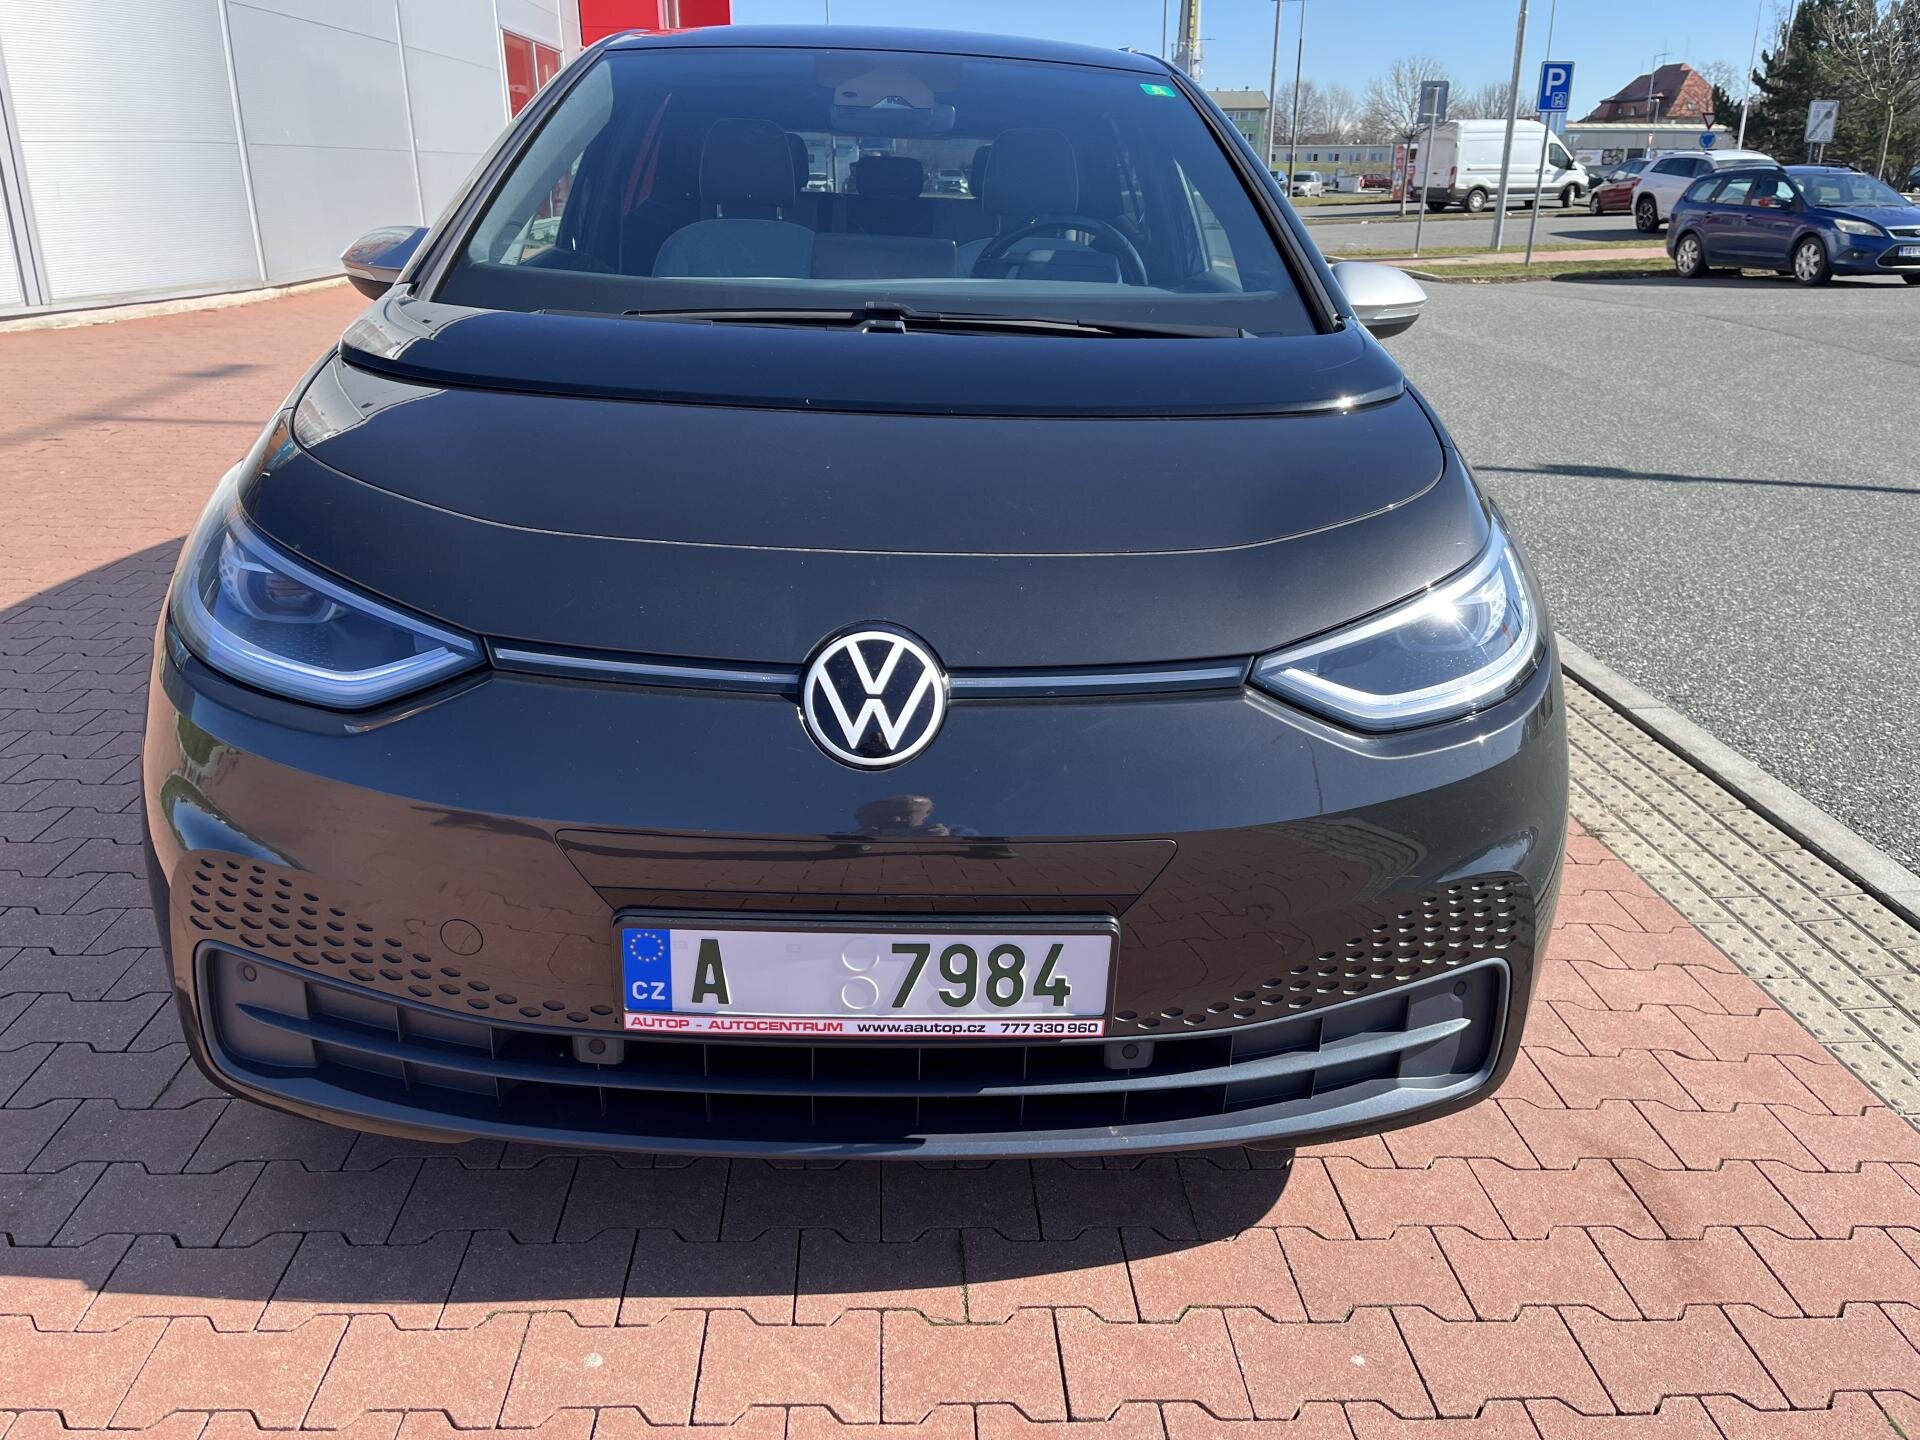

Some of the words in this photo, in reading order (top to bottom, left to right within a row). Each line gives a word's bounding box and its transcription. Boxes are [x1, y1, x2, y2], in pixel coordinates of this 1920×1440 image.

[1545, 68, 1567, 97] P
[691, 938, 732, 1005] A
[891, 943, 1072, 1008] 7984
[631, 981, 666, 1000] CZ
[630, 1016, 690, 1029] AUTOP
[708, 1020, 843, 1032] AUTOCENTRUM
[856, 1022, 986, 1035] www.aautop.cz
[1000, 1022, 1031, 1034] 777
[1033, 1022, 1065, 1034] 330
[1067, 1022, 1098, 1034] 960
